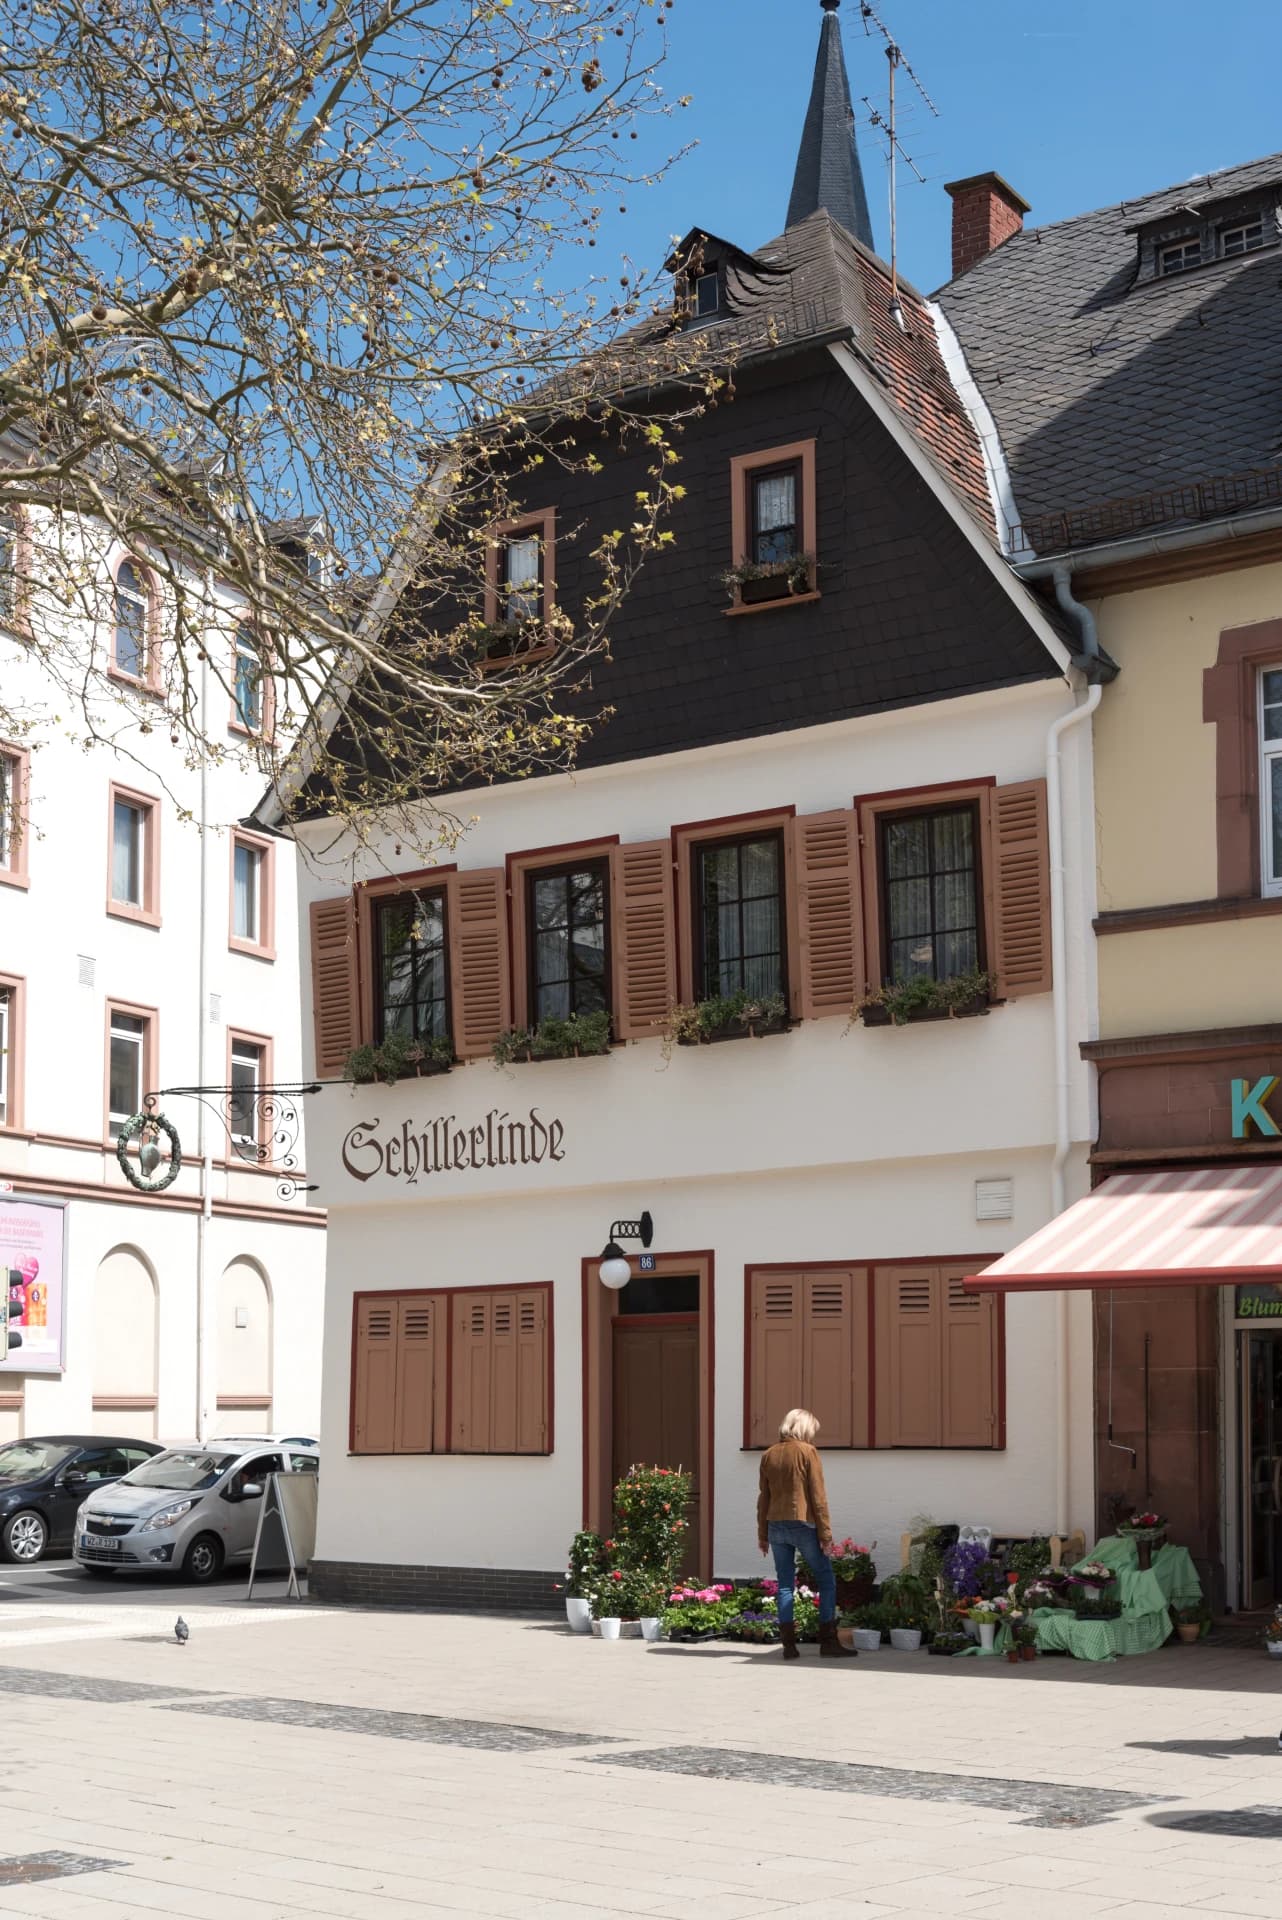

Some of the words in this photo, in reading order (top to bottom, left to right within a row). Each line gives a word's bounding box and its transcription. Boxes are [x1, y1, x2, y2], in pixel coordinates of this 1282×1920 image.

[1231, 1075, 1282, 1138] K
[342, 1107, 566, 1184] Schillerlinde
[641, 1256, 652, 1269] 86
